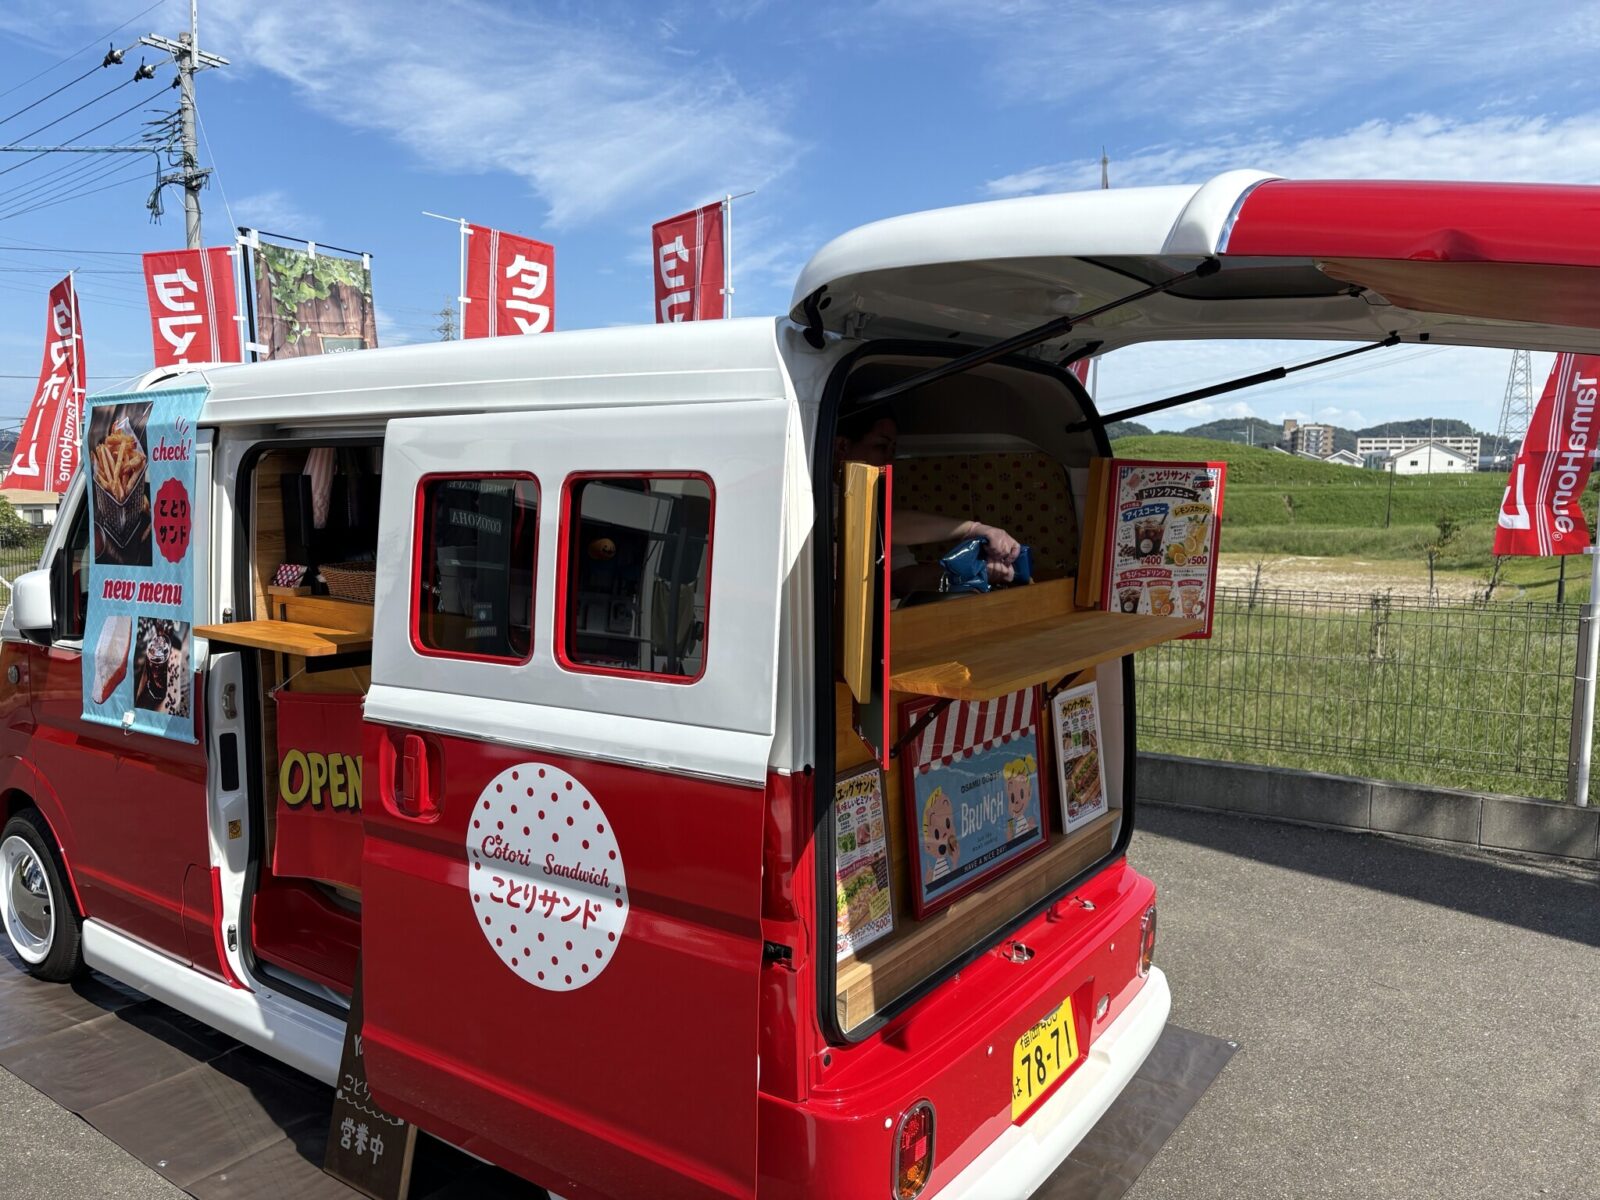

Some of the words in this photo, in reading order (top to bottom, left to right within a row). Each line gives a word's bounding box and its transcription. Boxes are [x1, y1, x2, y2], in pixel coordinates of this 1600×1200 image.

[152, 436, 191, 462] check!
[1148, 470, 1191, 483] ことりサンド
[1142, 488, 1195, 500] ドリンクメニュー
[159, 498, 188, 518] ことり
[1125, 506, 1166, 520] アイスコーヒー
[1174, 505, 1210, 517] レモンスカッシュ
[159, 523, 188, 545] サンド
[1141, 555, 1162, 565] ¥400
[1187, 555, 1208, 565] ¥500
[102, 578, 136, 603] new
[137, 579, 183, 606] menu
[279, 748, 363, 811] OPEN
[960, 790, 1004, 838] BRUNCH
[543, 853, 611, 888] Sandwich
[489, 876, 602, 930] ことりサンド
[1021, 1020, 1073, 1098] 78-71
[340, 1117, 384, 1165] 営業中
